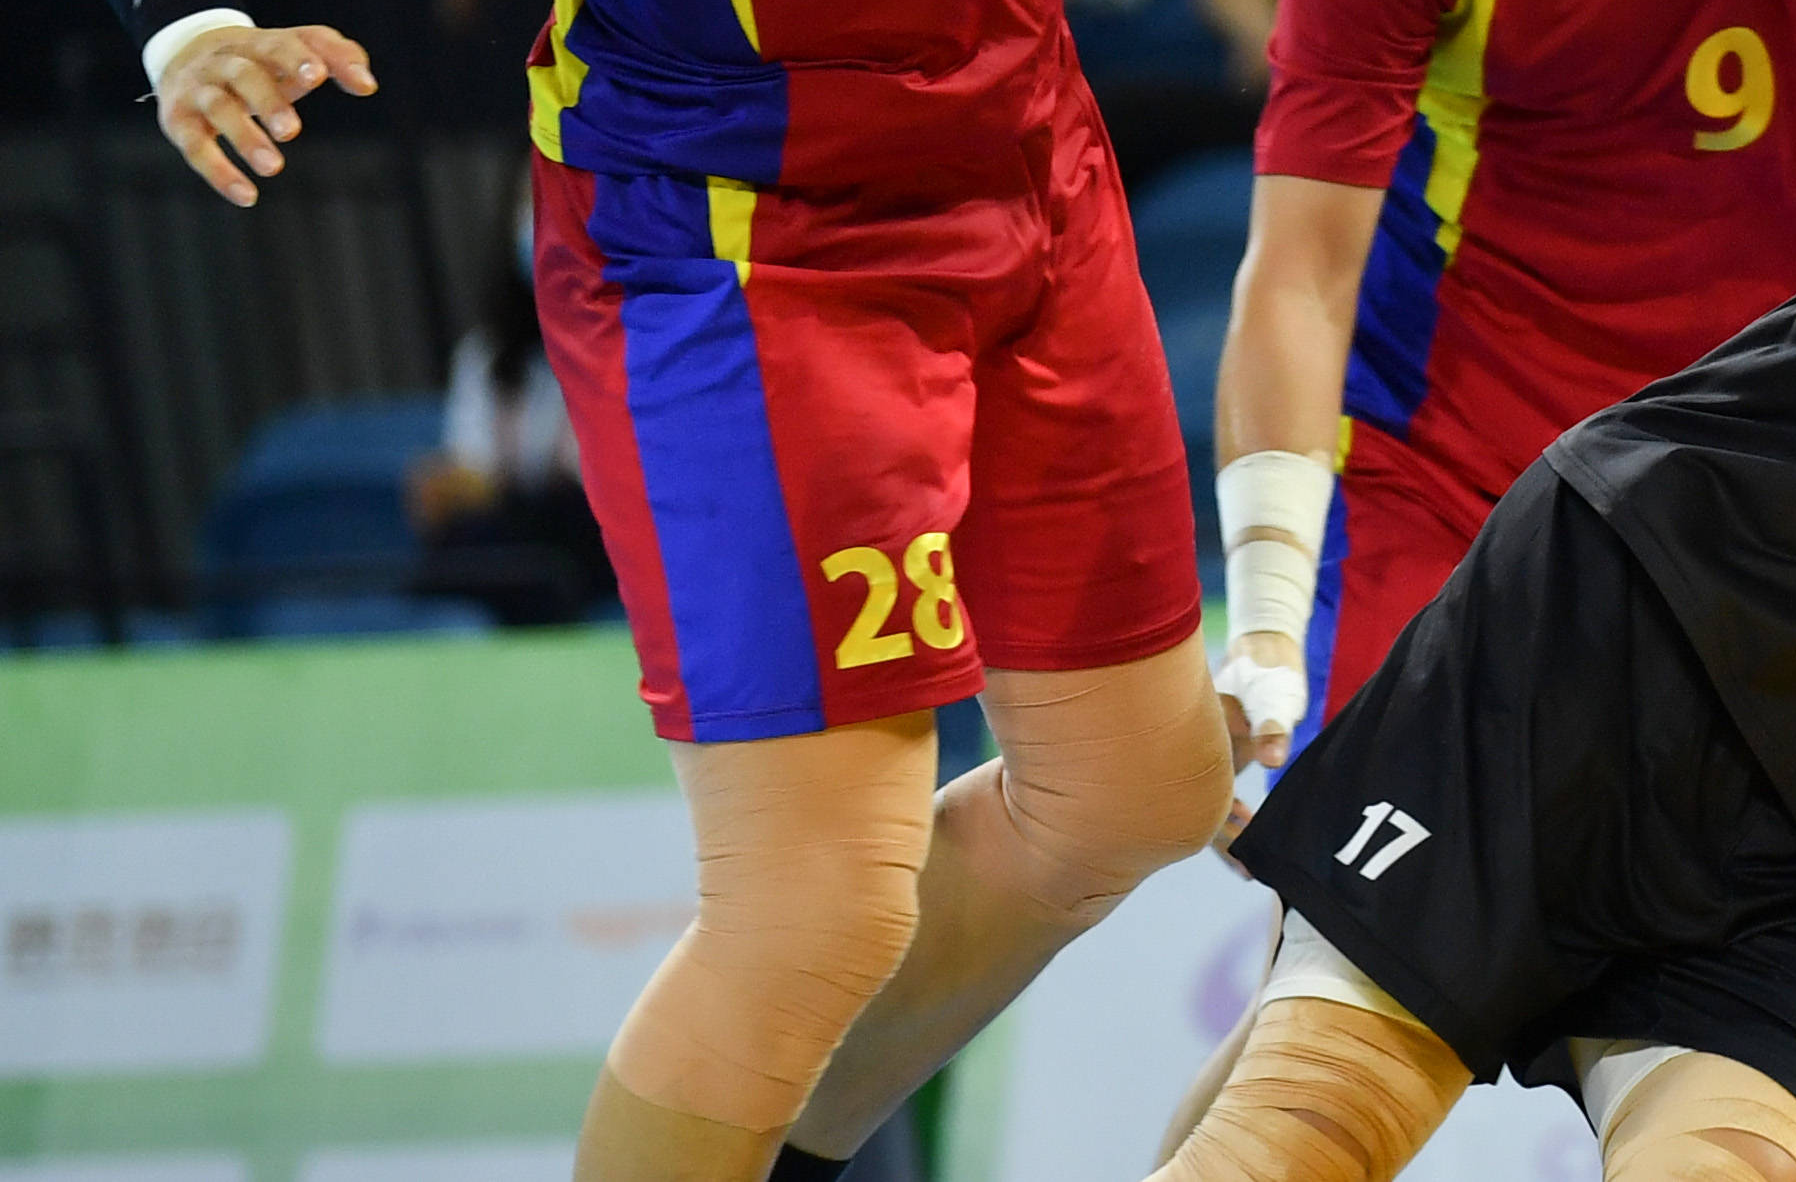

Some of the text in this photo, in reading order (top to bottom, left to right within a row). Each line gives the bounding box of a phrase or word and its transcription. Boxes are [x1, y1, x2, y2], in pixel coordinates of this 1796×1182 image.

[1685, 26, 1775, 152] 9
[820, 531, 965, 670] 28
[1333, 800, 1433, 881] 17
